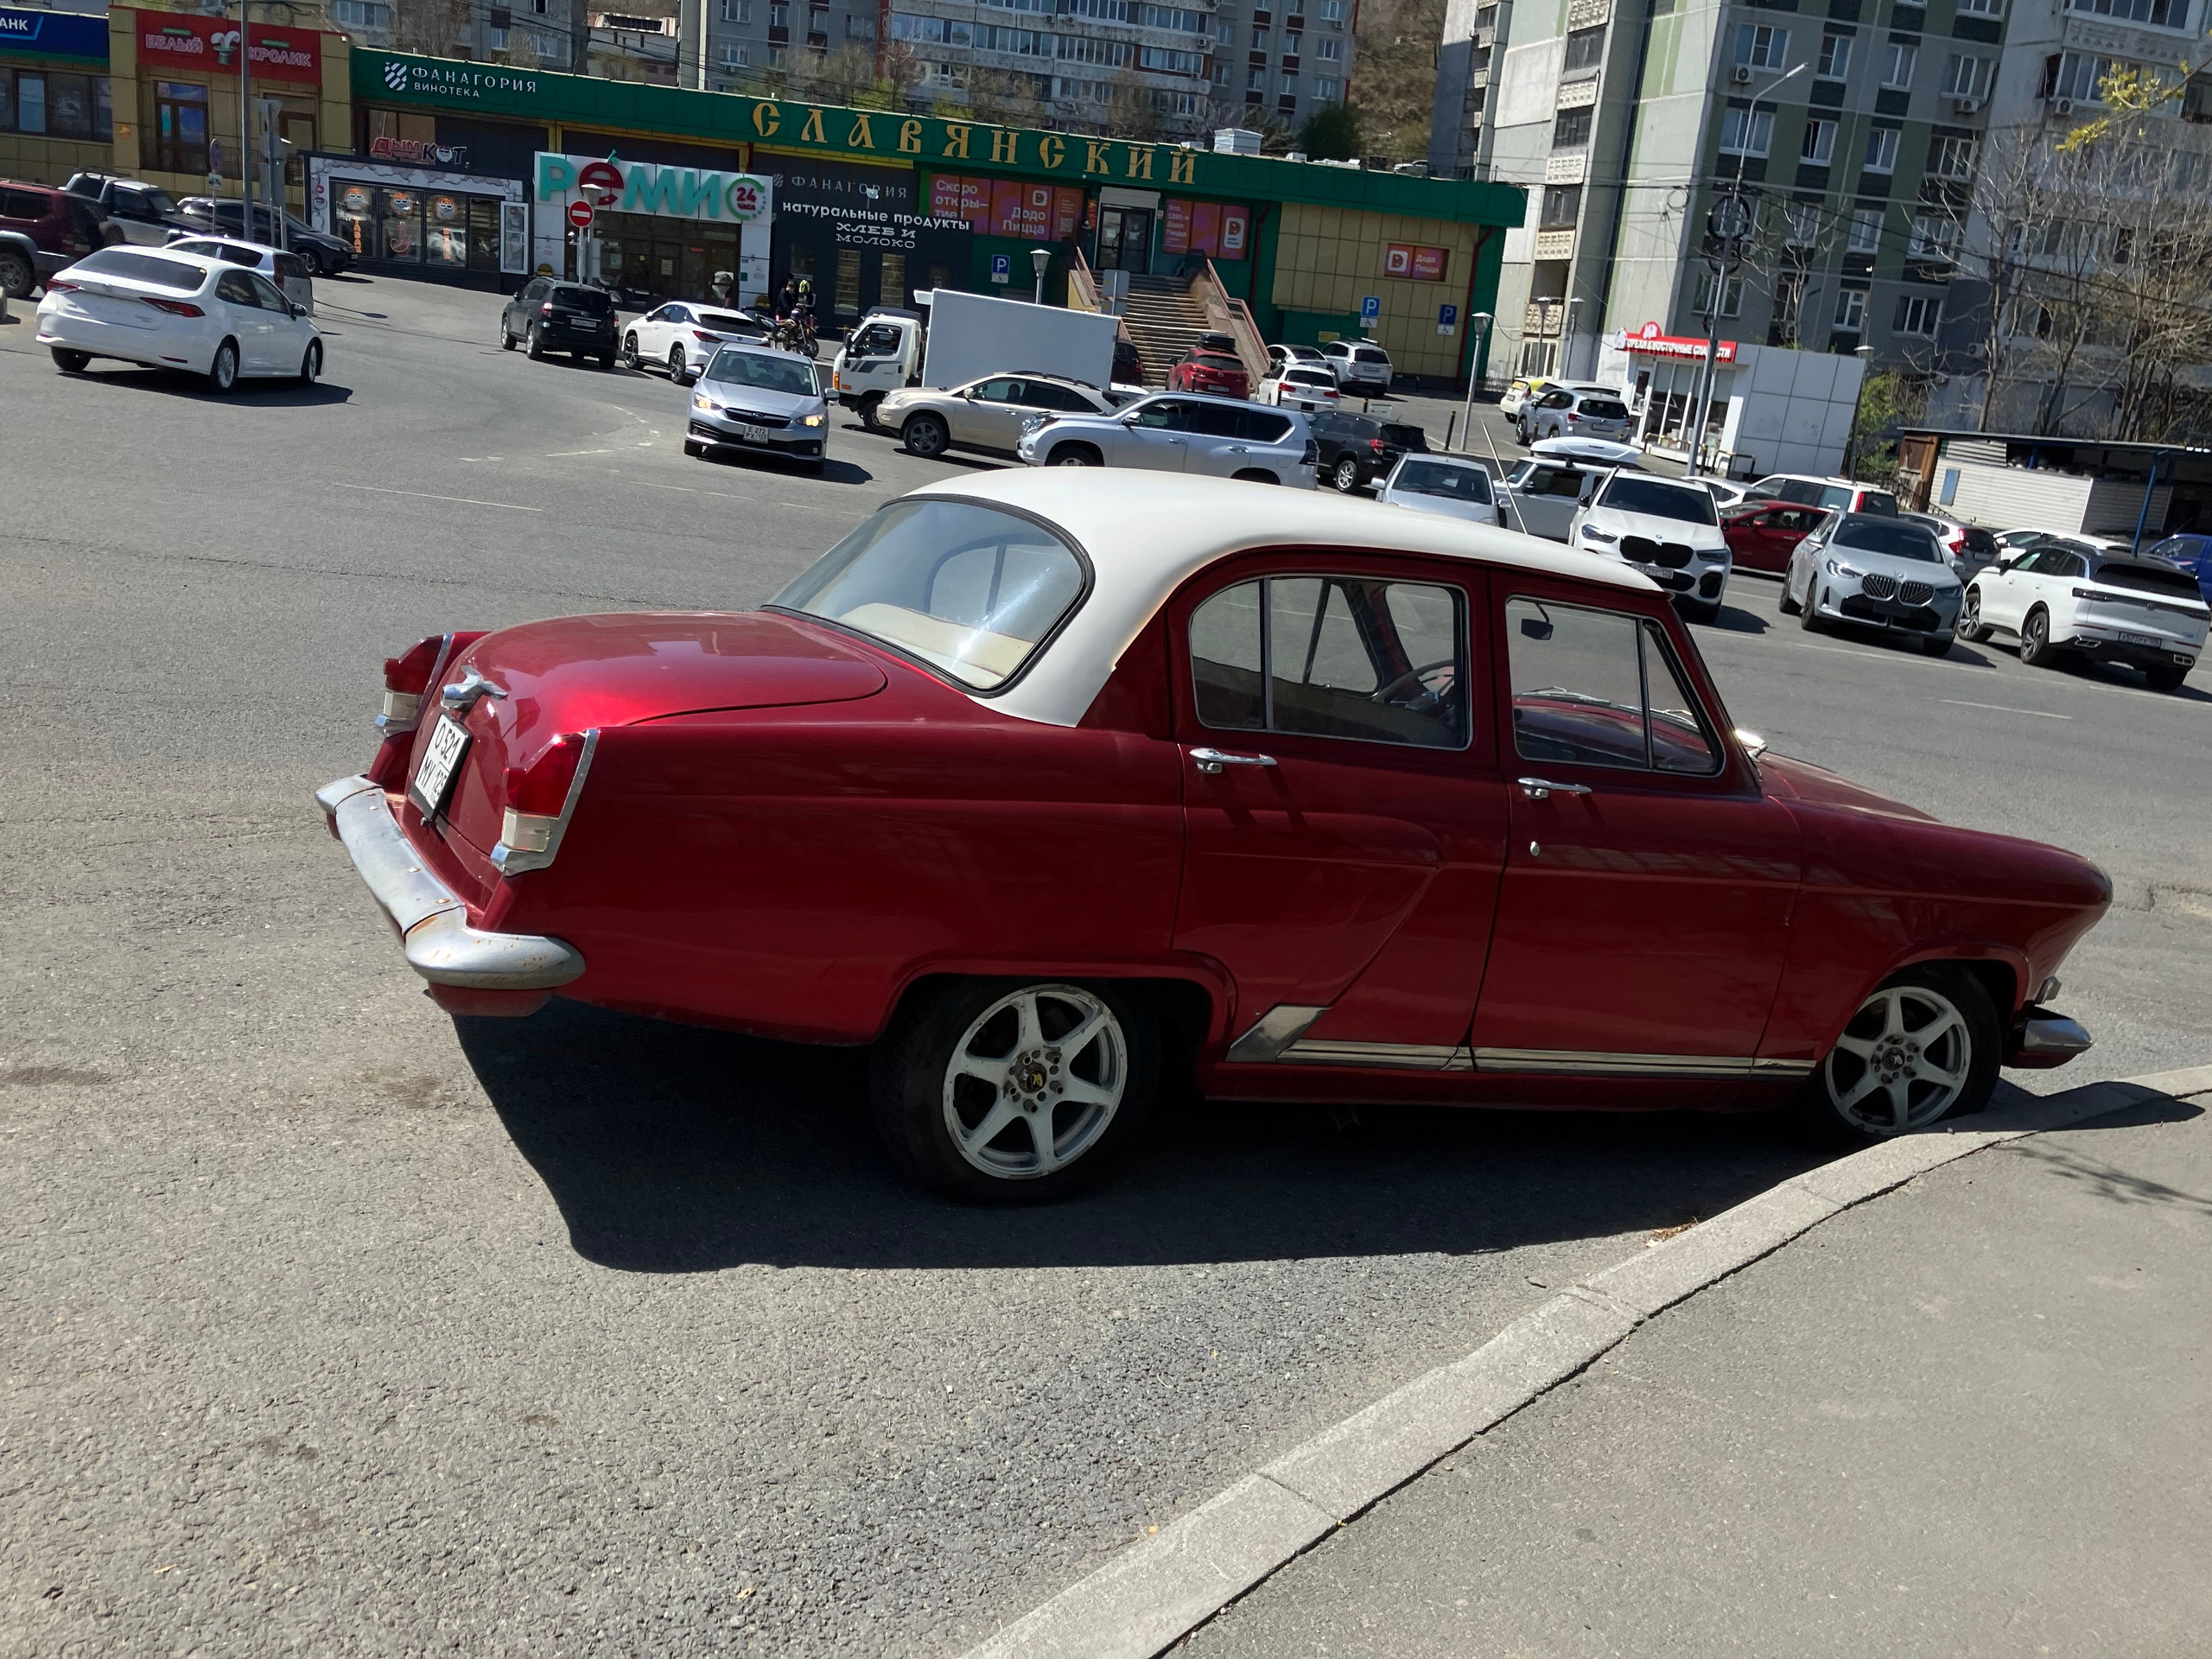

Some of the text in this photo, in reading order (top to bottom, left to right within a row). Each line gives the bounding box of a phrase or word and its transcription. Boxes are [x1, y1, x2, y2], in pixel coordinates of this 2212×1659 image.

[145, 34, 203, 54] БЕЛЫЙ
[412, 67, 536, 92] ФАНАГОРИЯ
[414, 82, 480, 98] ВИНОТЕКА
[753, 102, 1198, 185] СЛАВЯНСКИЙ
[736, 187, 757, 202] 24
[791, 175, 907, 199] ФАНАГОРИЯ
[936, 179, 977, 195] Скоро
[783, 201, 969, 231] натуральные продукты
[1011, 207, 1046, 221] Додо
[836, 222, 916, 238] ХЛЕБ И
[1002, 219, 1045, 234] Пицца
[836, 233, 916, 249] МОЛОКО
[1365, 298, 1377, 315] P
[1443, 306, 1453, 322] P
[441, 728, 461, 765] 521
[433, 769, 448, 796] 125
